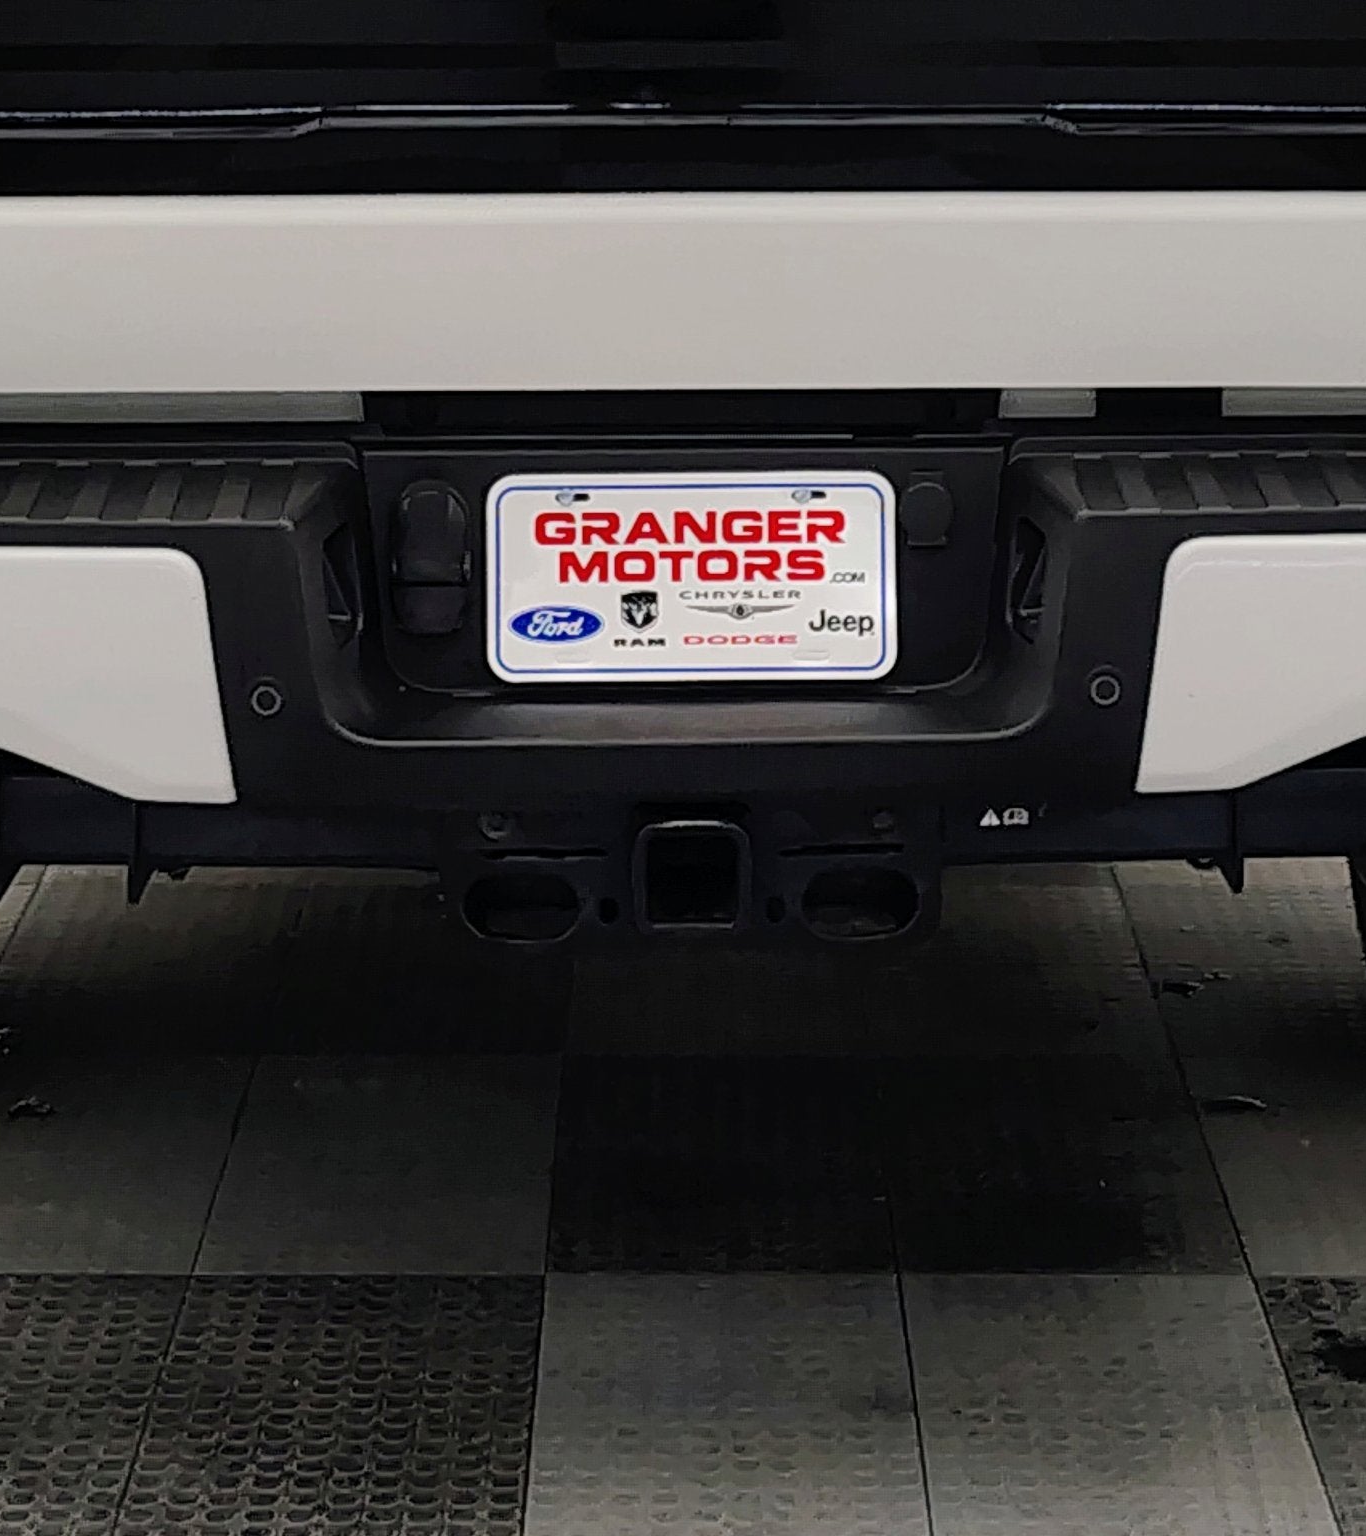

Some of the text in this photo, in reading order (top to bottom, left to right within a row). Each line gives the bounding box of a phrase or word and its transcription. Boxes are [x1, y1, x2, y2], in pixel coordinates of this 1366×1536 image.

[535, 511, 846, 546] GRANGER
[559, 551, 825, 583] MOTORS
[679, 590, 802, 600] CHRYSLER
[526, 610, 585, 638] Ford
[809, 610, 874, 636] Jeep
[614, 638, 666, 647] RAM
[683, 635, 798, 645] DODGE
